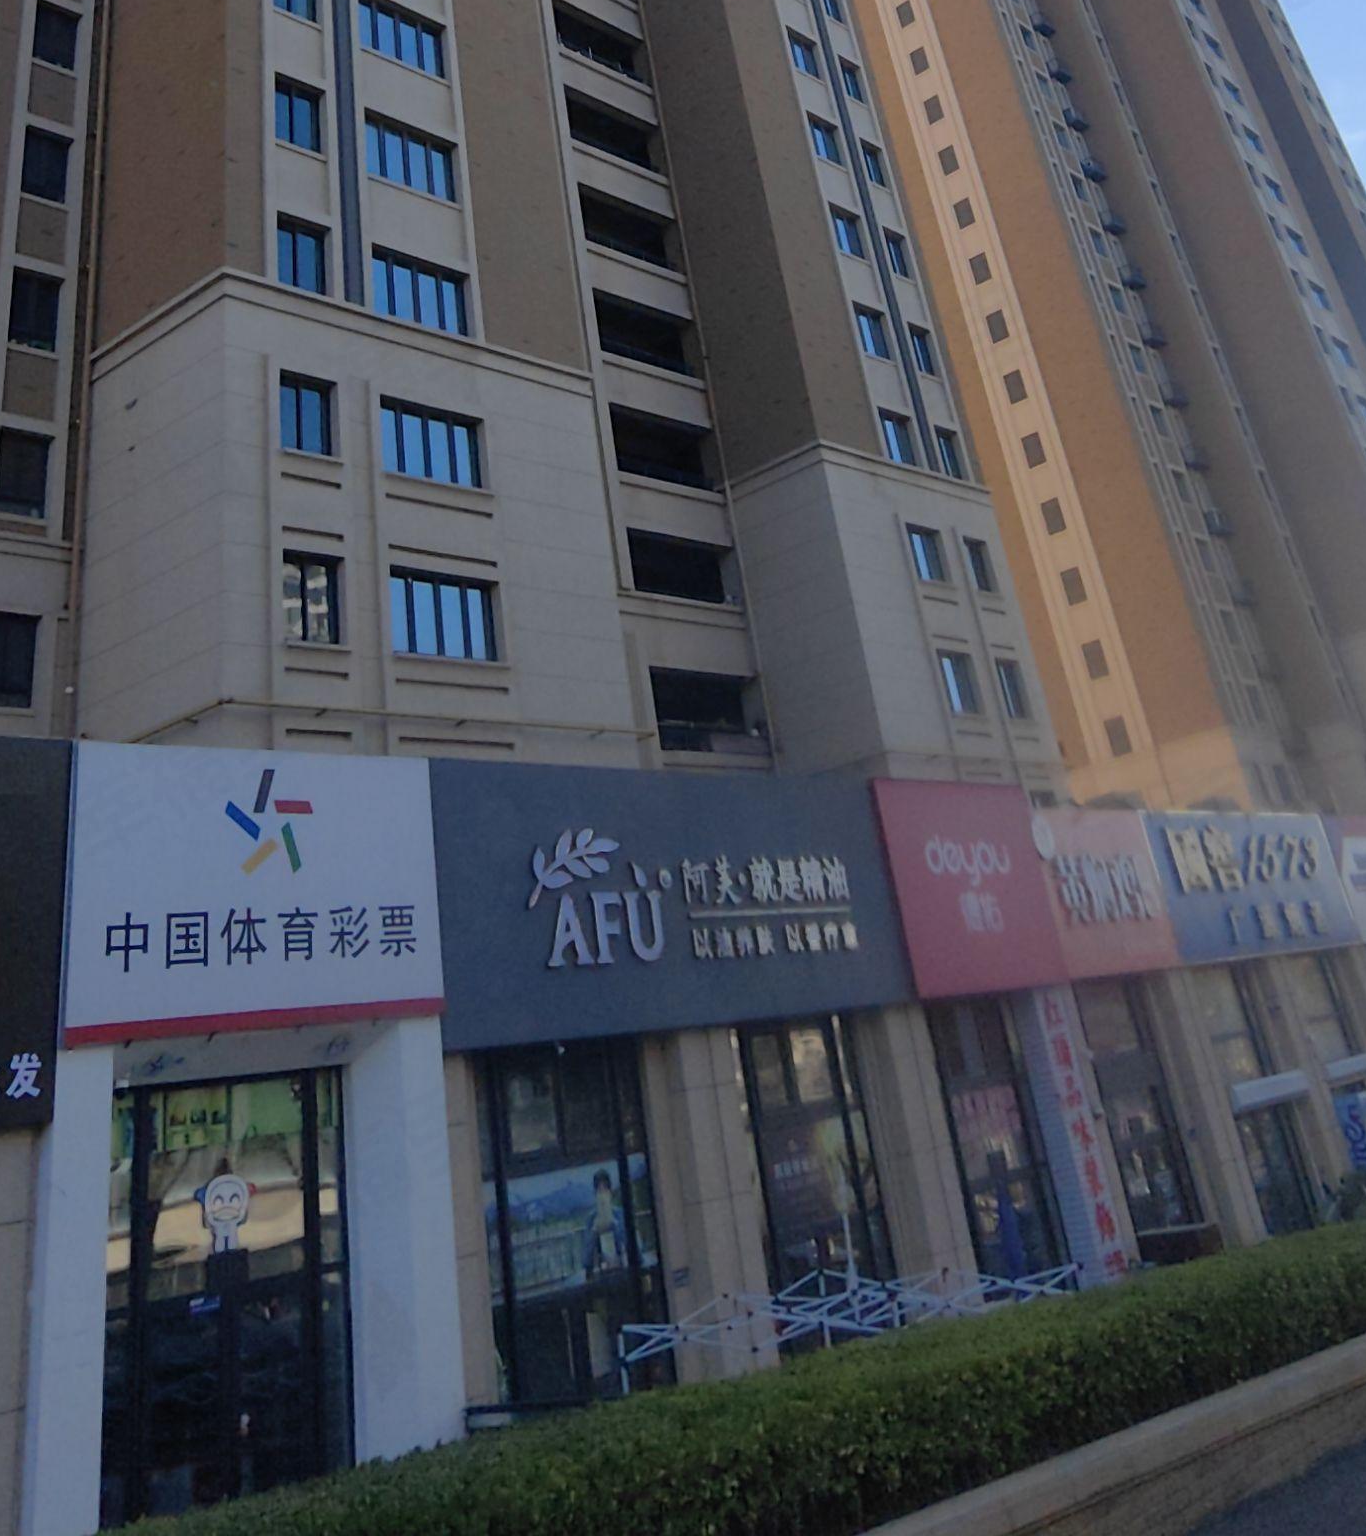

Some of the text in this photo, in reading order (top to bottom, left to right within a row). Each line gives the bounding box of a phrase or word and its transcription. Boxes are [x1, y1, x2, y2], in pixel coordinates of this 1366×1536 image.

[924, 833, 1011, 886] deyou
[104, 904, 417, 975] 中国体育彩票
[546, 884, 666, 970] AFU
